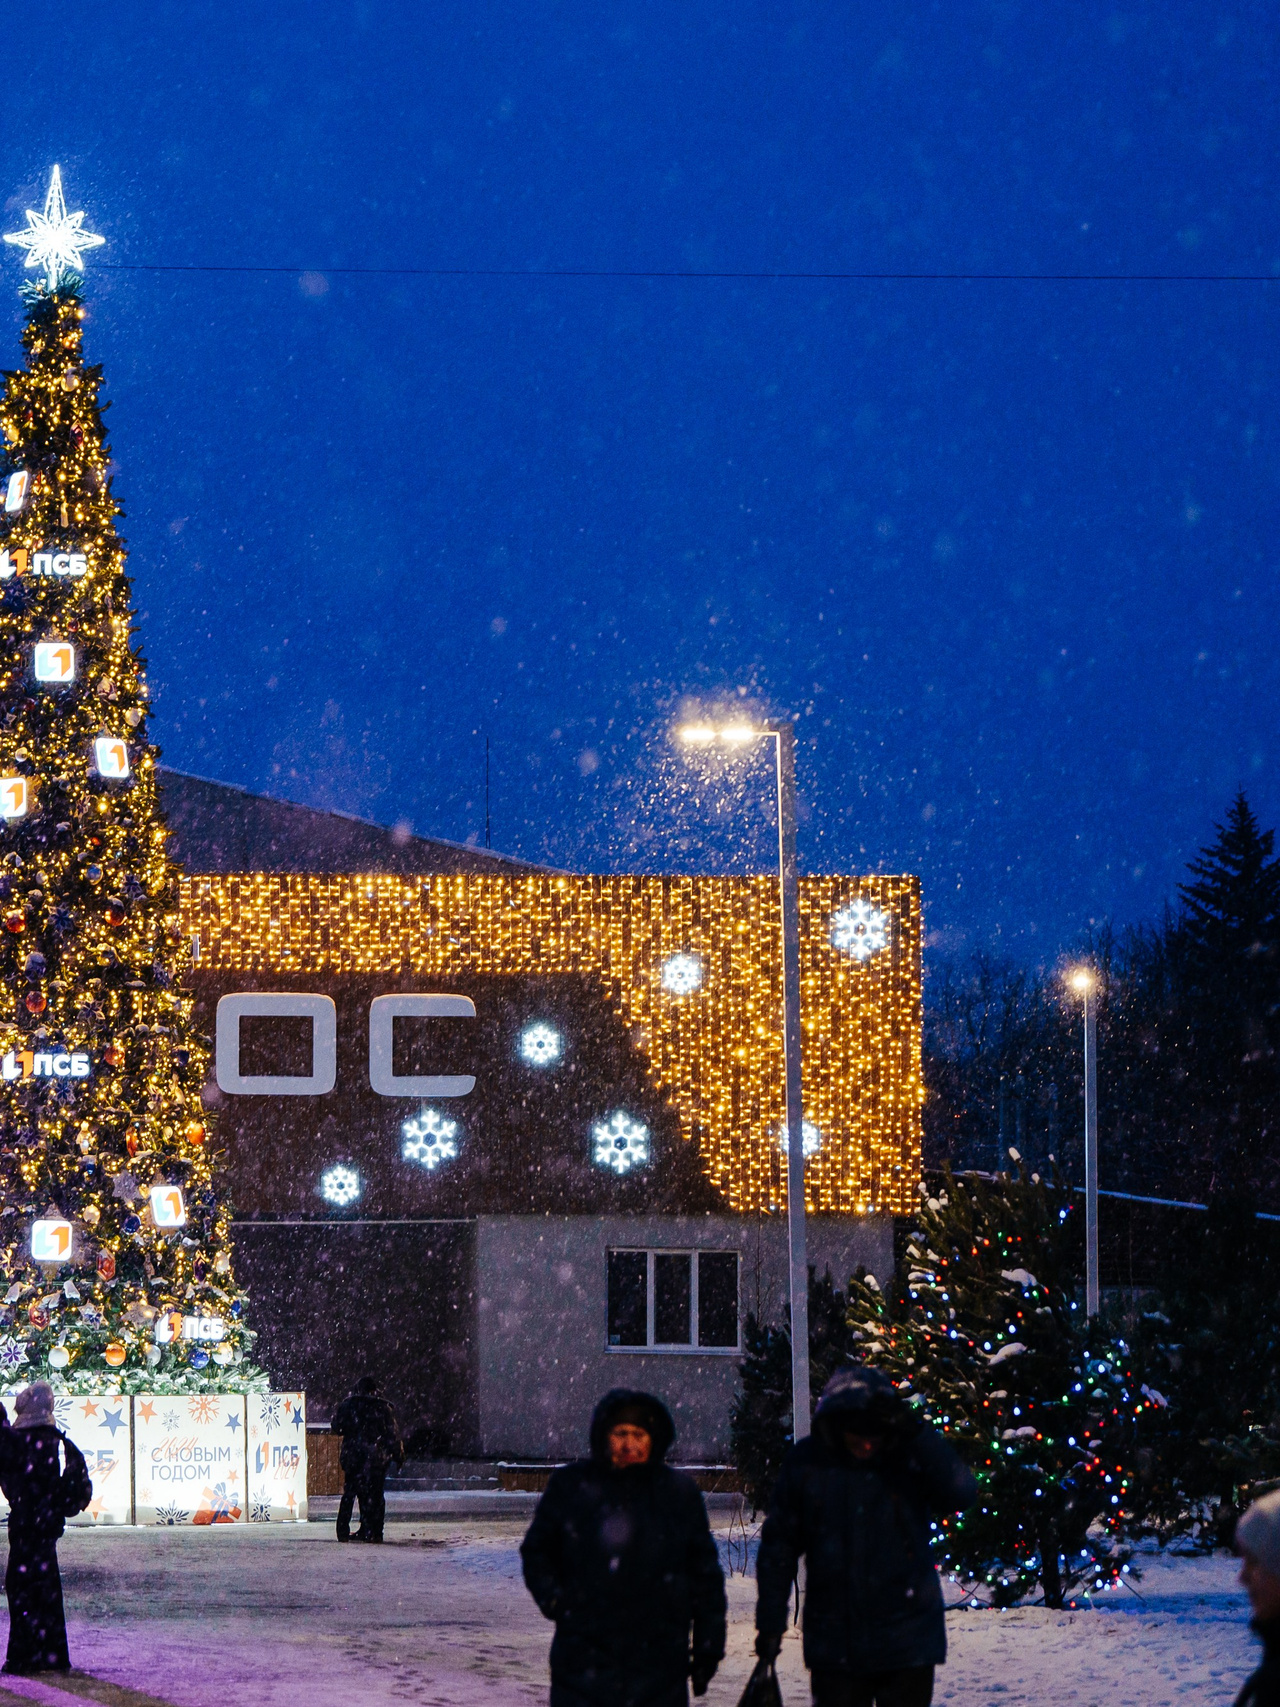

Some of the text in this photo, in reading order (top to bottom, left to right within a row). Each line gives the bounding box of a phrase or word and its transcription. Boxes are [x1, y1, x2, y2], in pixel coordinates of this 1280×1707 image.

[32, 553, 88, 576] ПСБ
[33, 1053, 91, 1077] ПСБ
[183, 1316, 224, 1340] ПСБ
[151, 1446, 231, 1463] С НОВЫМ
[272, 1445, 300, 1468] ПСБ
[151, 1464, 211, 1483] ГОДОМ
